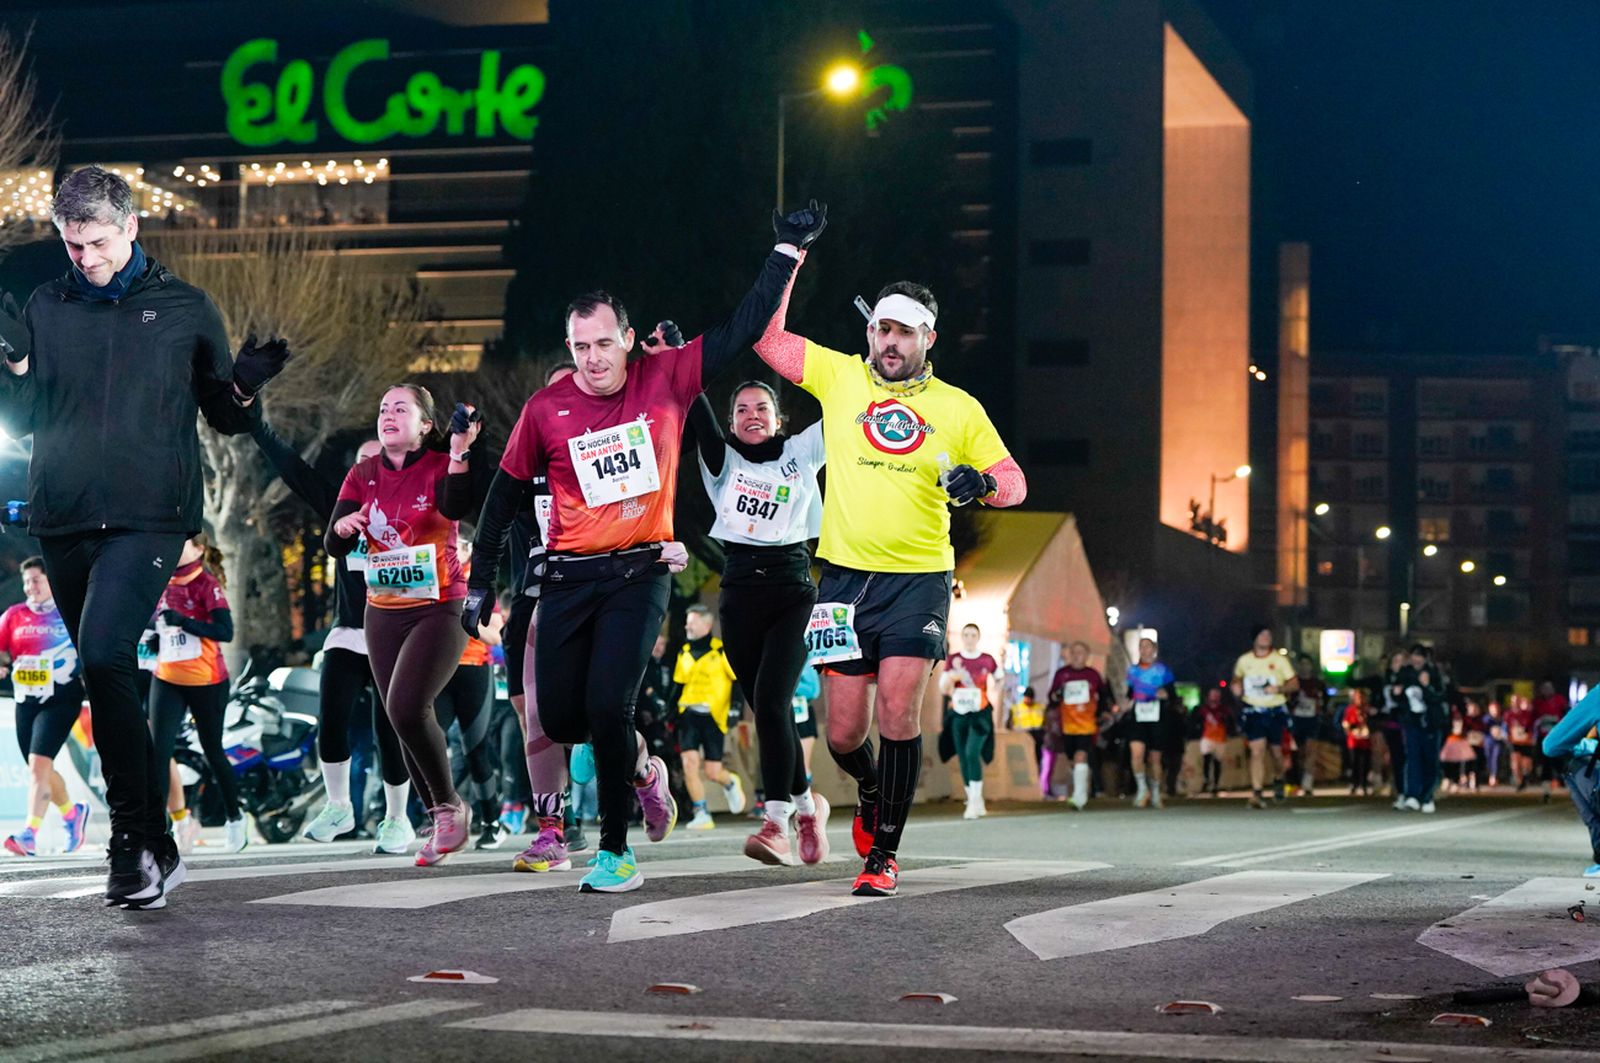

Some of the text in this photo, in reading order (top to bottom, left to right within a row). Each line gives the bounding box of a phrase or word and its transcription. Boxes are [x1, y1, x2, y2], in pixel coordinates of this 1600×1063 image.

[220, 38, 545, 146] El Corte
[587, 437, 611, 449] NOCHE
[611, 434, 621, 442] DE
[580, 442, 624, 461] SAN ANTÓN
[591, 448, 641, 480] 1434
[857, 456, 884, 469] Siempre
[735, 484, 747, 493] SAN
[744, 479, 763, 489] NOCHE
[736, 494, 779, 521] 6347
[377, 565, 424, 585] 6205
[821, 611, 829, 619] DE
[810, 619, 830, 628] NTÓN
